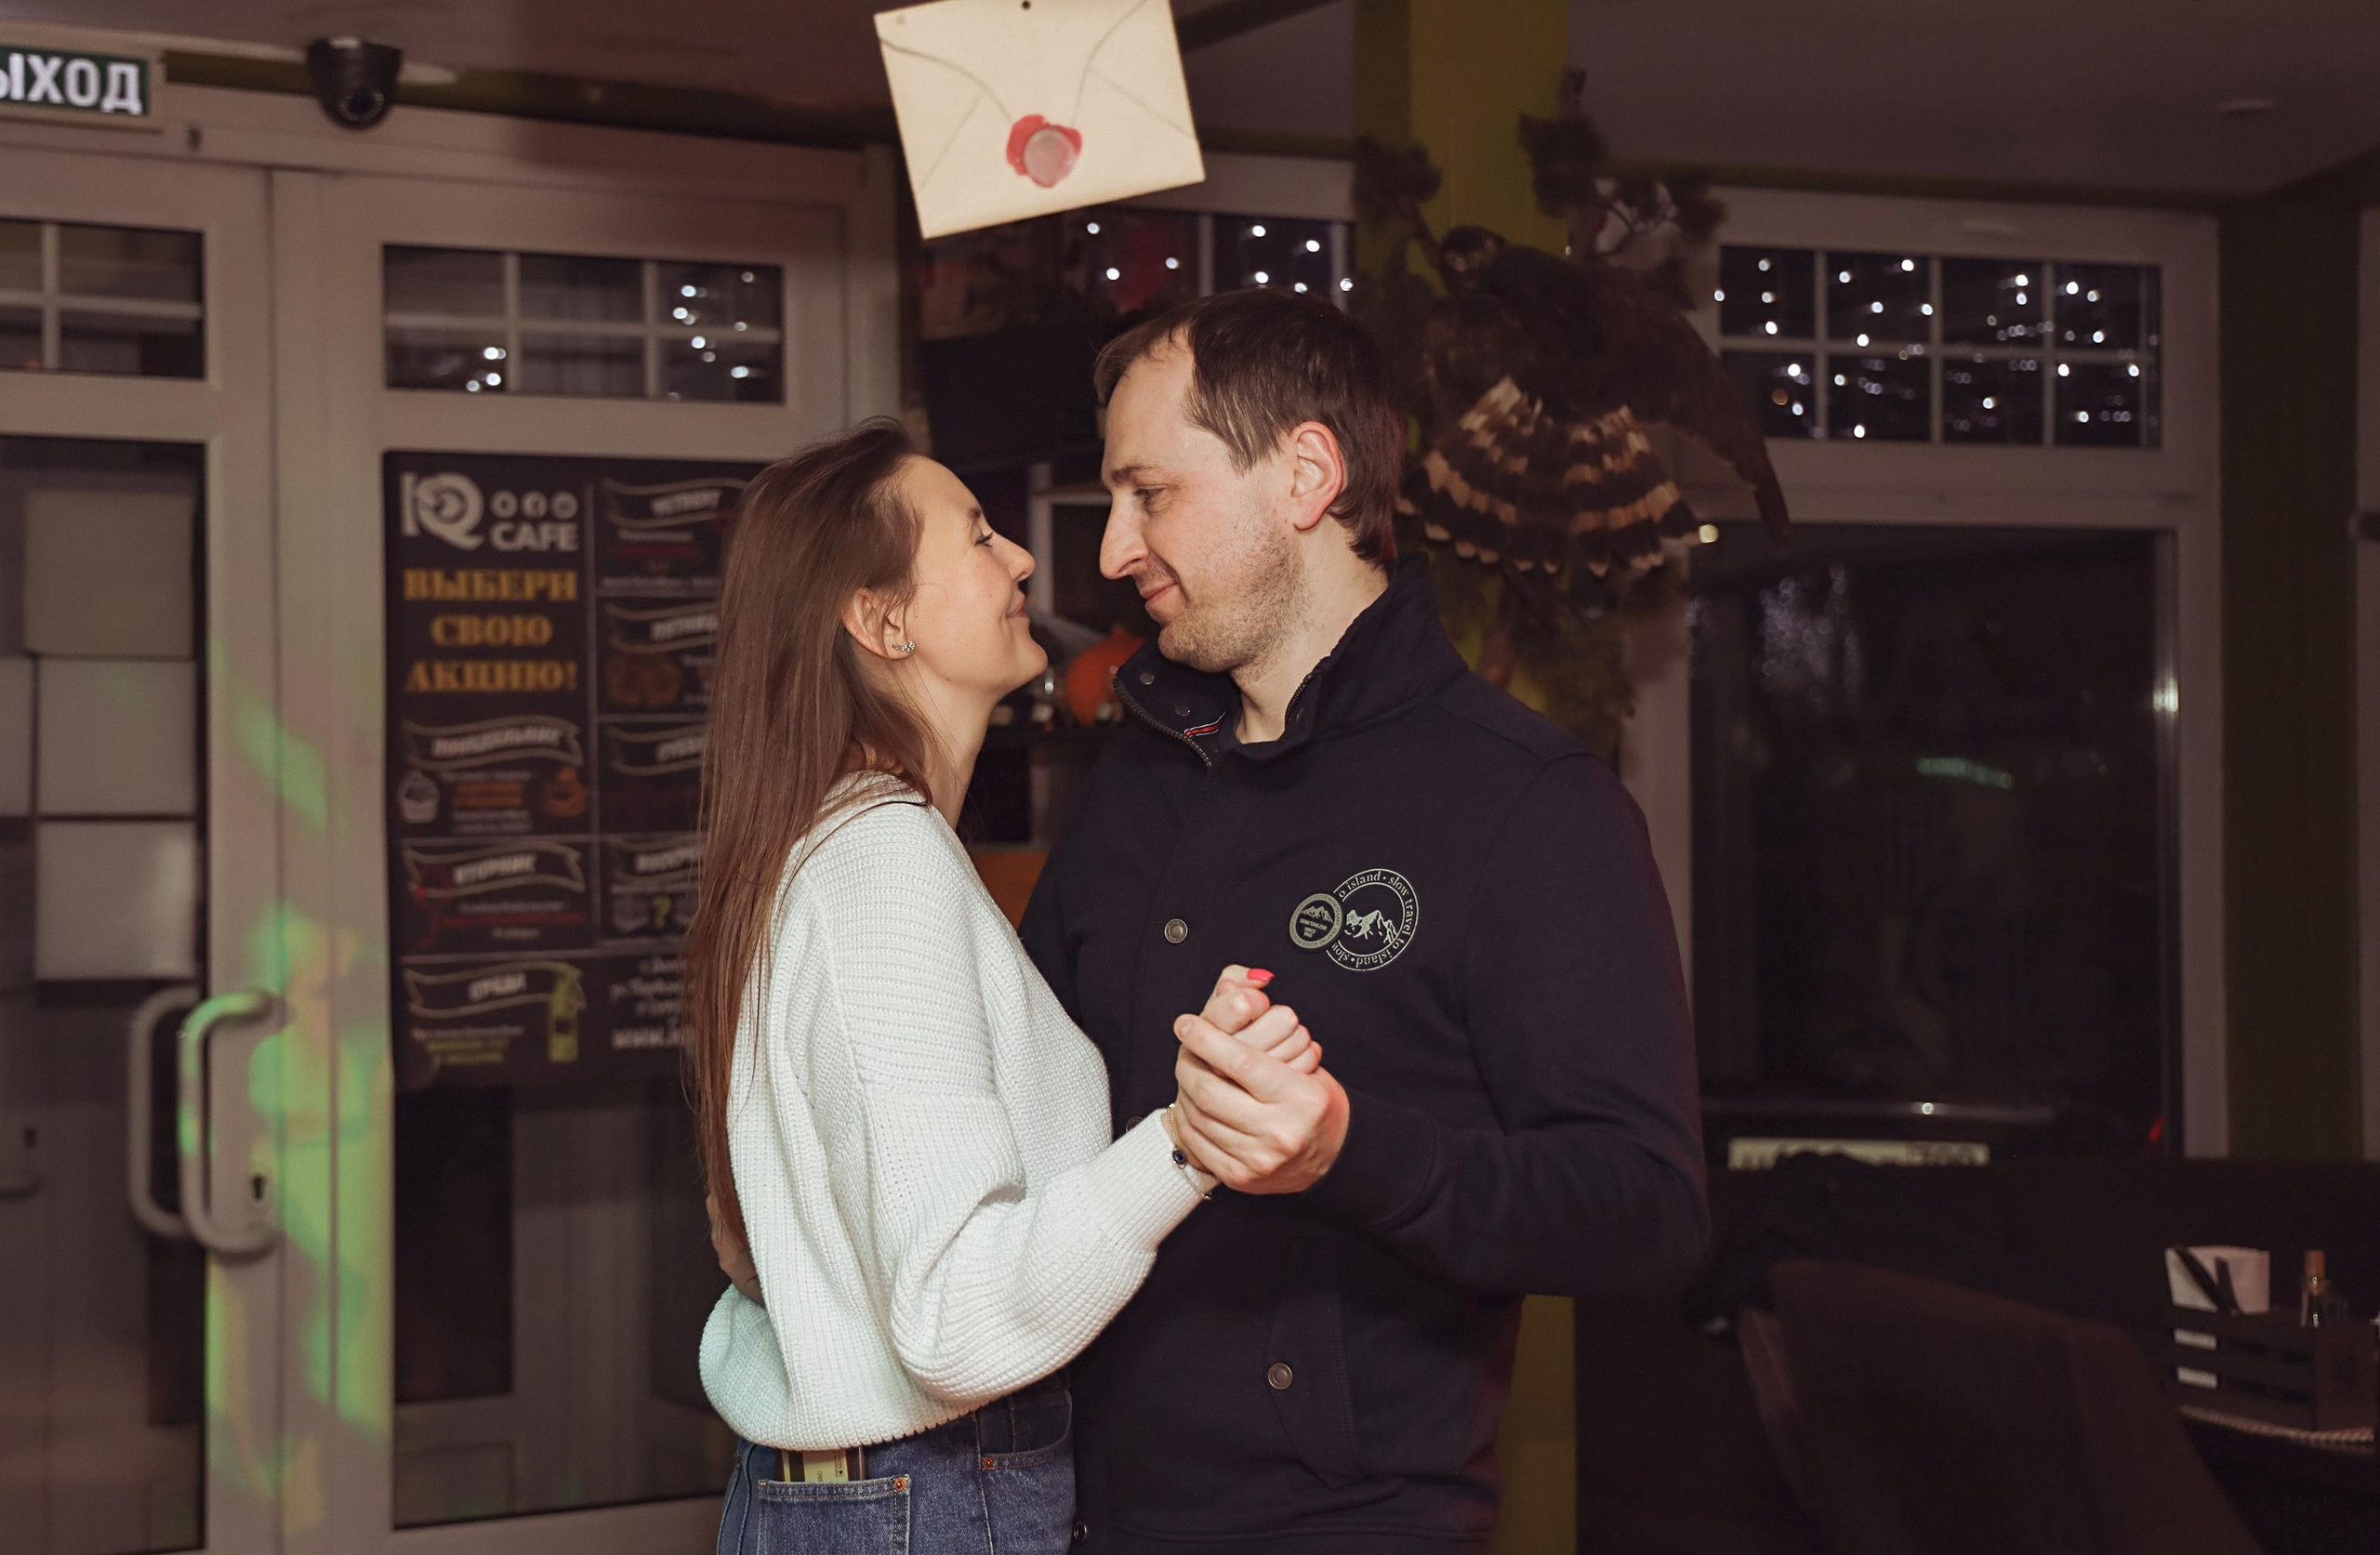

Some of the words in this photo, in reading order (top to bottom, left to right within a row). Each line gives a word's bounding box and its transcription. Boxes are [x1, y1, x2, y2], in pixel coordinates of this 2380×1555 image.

[489, 521, 580, 553] CAFE
[403, 568, 578, 602] ВЫБЕРИ
[430, 613, 554, 648] СВОЮ
[404, 659, 578, 692] АКЦИЮ!
[1346, 871, 1382, 890] island
[1388, 876, 1409, 896] slow
[1403, 899, 1413, 935] travel
[1355, 949, 1393, 968] island
[1392, 938, 1405, 949] to
